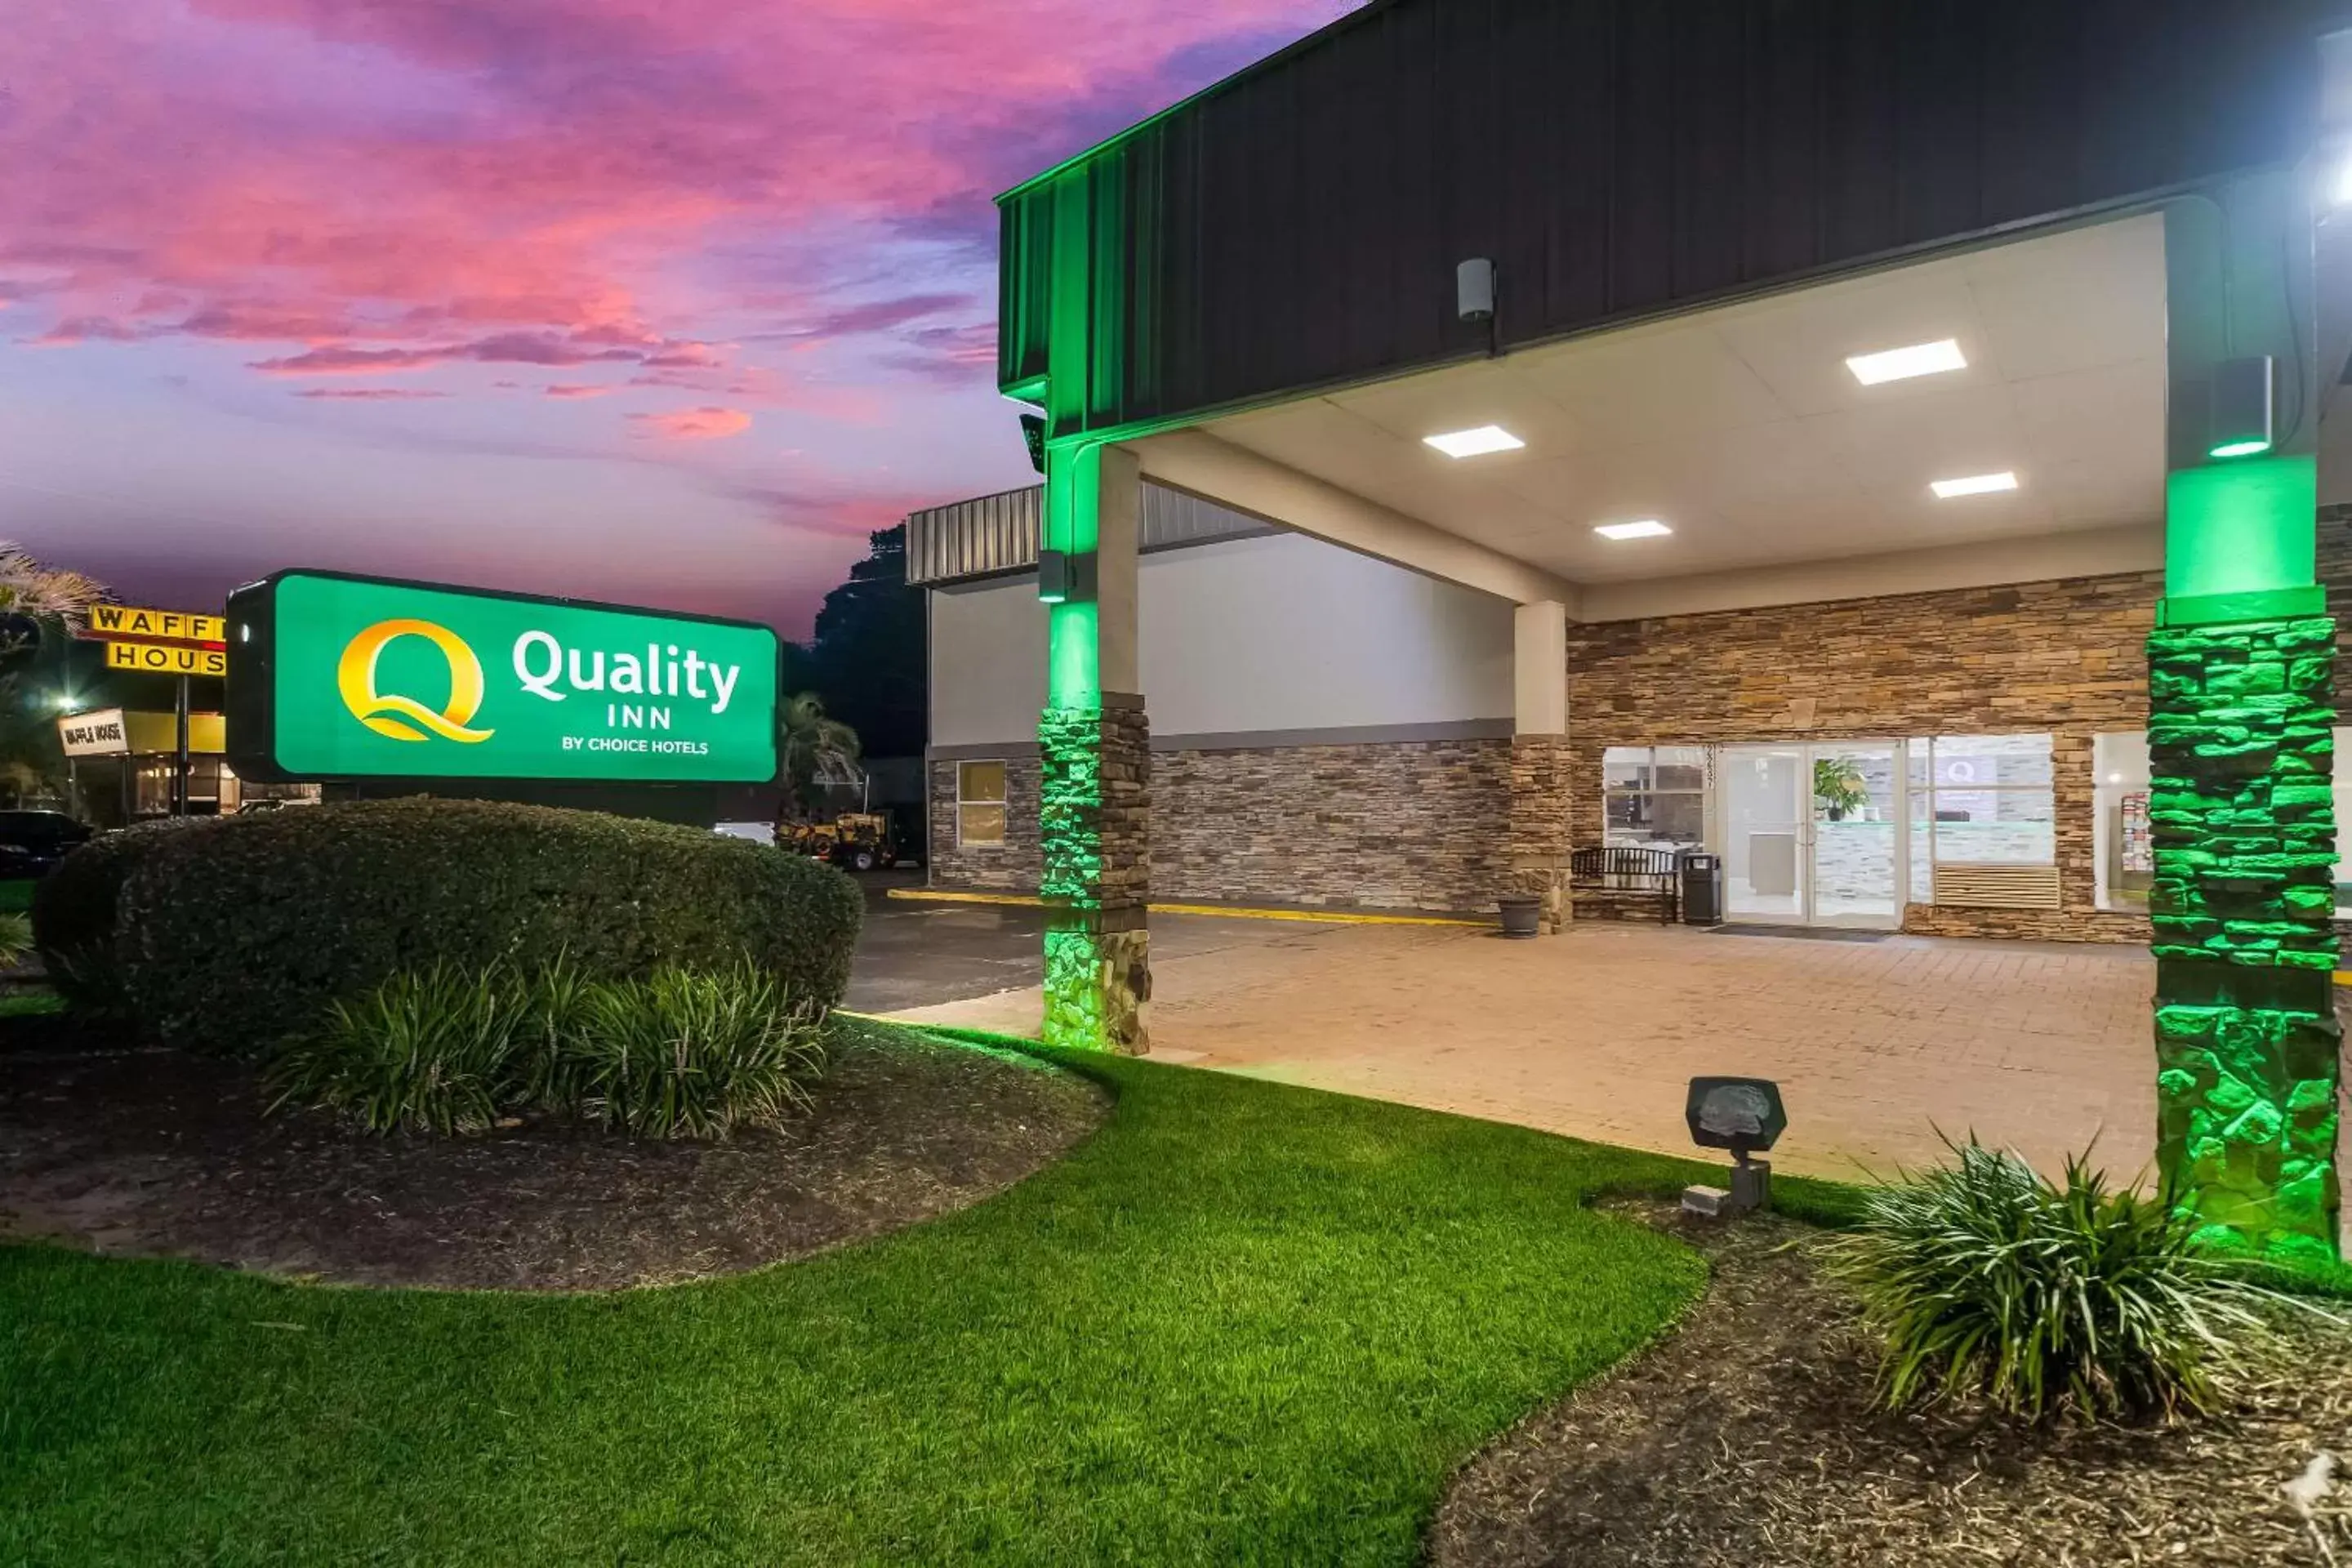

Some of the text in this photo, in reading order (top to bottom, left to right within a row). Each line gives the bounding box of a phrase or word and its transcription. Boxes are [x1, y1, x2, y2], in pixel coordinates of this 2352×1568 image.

[97, 608, 226, 639] WAFF
[337, 618, 495, 743] Q
[512, 630, 740, 714] Quality
[607, 703, 671, 730] INN
[562, 736, 709, 755] BY CHOICE HOTELS
